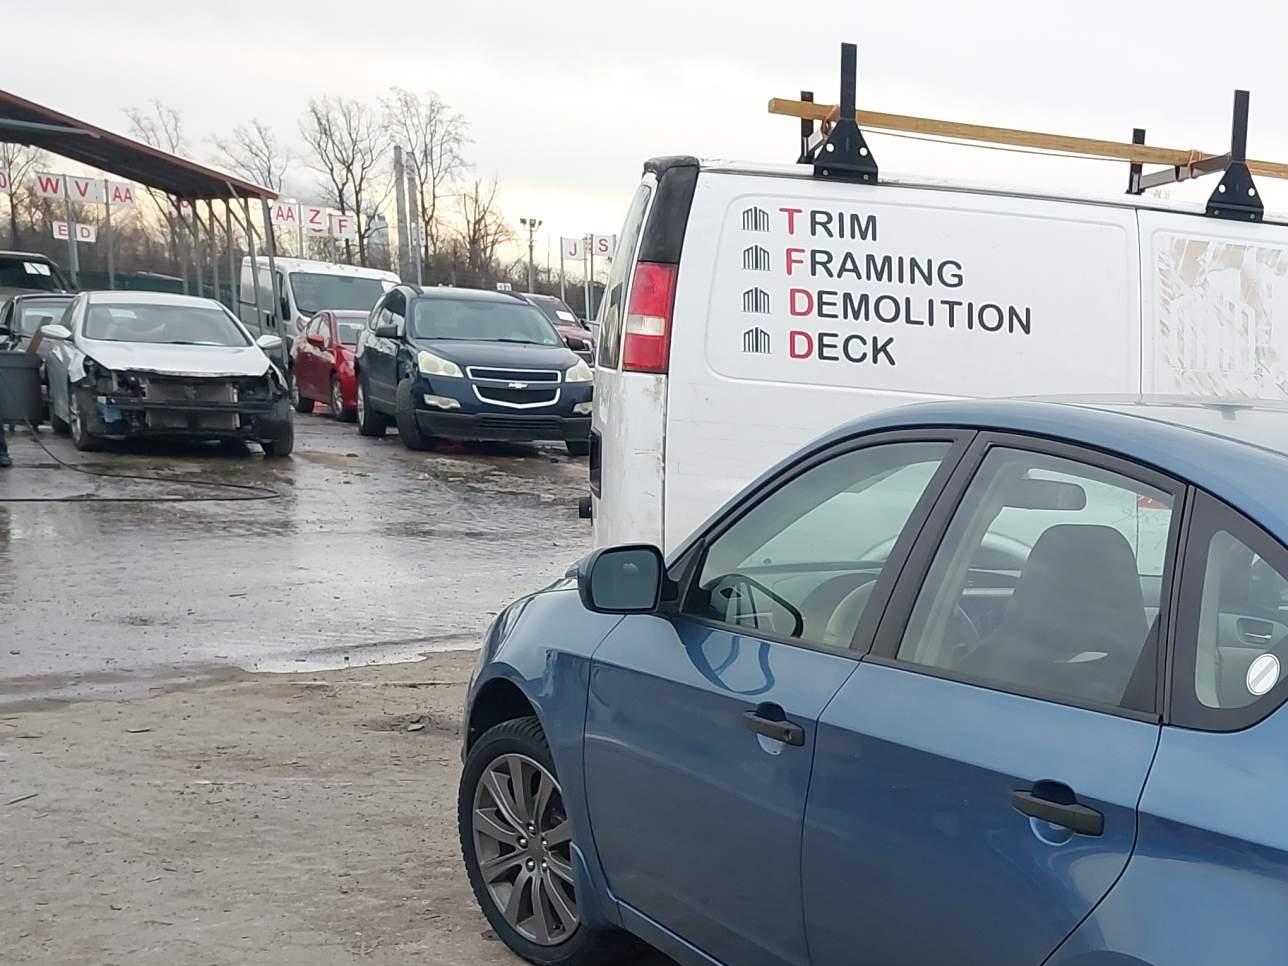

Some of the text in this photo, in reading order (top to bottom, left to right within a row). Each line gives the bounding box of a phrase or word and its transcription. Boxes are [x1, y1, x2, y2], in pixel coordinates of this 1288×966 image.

[38, 175, 59, 194] W
[75, 180, 89, 198] V
[112, 186, 134, 203] AA
[275, 206, 295, 222] AA
[309, 209, 321, 225] Z
[58, 224, 68, 236] E
[80, 226, 91, 239] D
[338, 219, 348, 234] F
[779, 207, 878, 242] TRIM
[568, 242, 577, 257] J
[598, 238, 609, 252] S
[785, 247, 964, 288] FRAMING
[789, 288, 1032, 335] DEMOLITION
[789, 330, 897, 366] DECK
